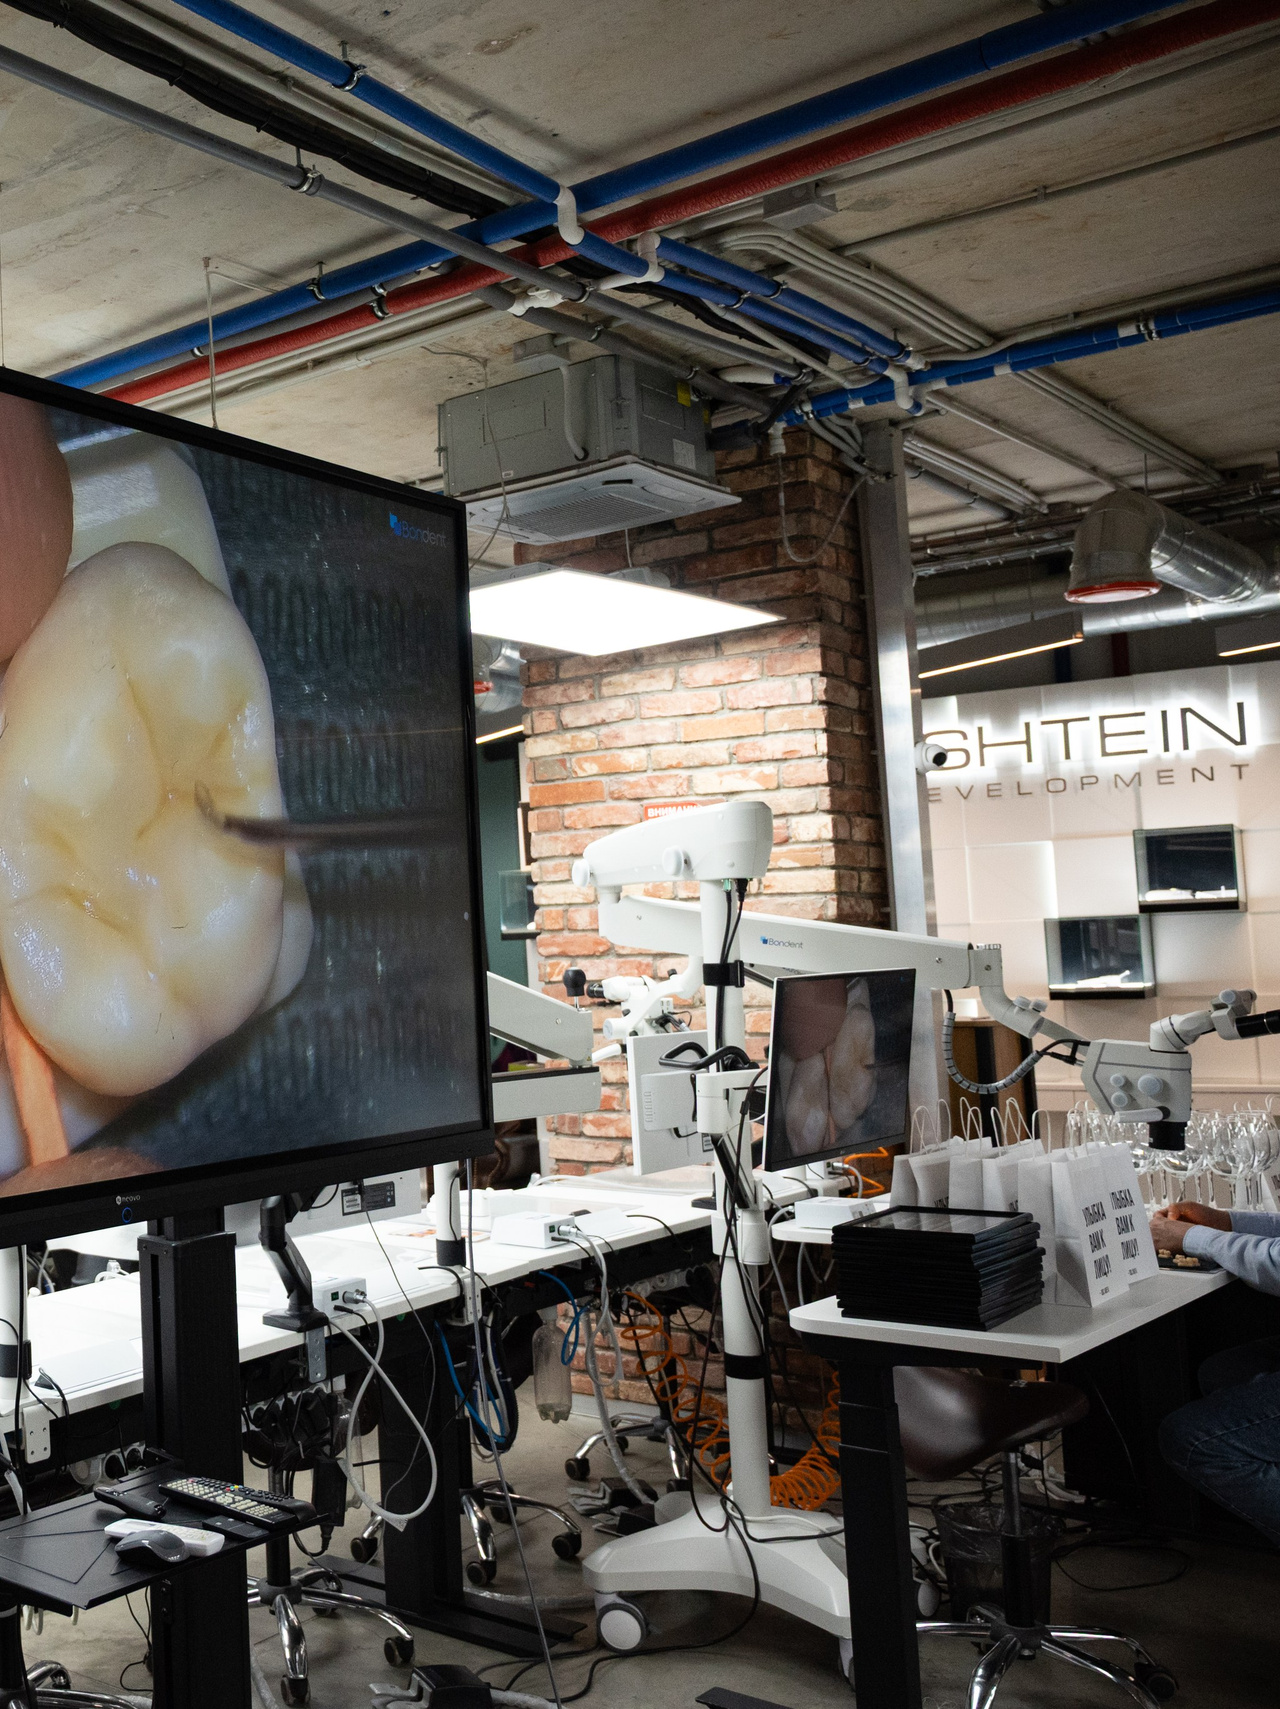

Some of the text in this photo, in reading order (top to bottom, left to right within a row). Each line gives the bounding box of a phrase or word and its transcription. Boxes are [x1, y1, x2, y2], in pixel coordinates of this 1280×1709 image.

[402, 520, 446, 547] Bondent
[924, 701, 1247, 772] SHTEIN
[768, 937, 803, 949] Bondent
[1115, 1213, 1135, 1236] ВАМ К
[1088, 1228, 1107, 1253] ВАМ К
[1121, 1238, 1140, 1260] ЛИЦУ!
[1094, 1254, 1112, 1280] ЛИЦУ!
